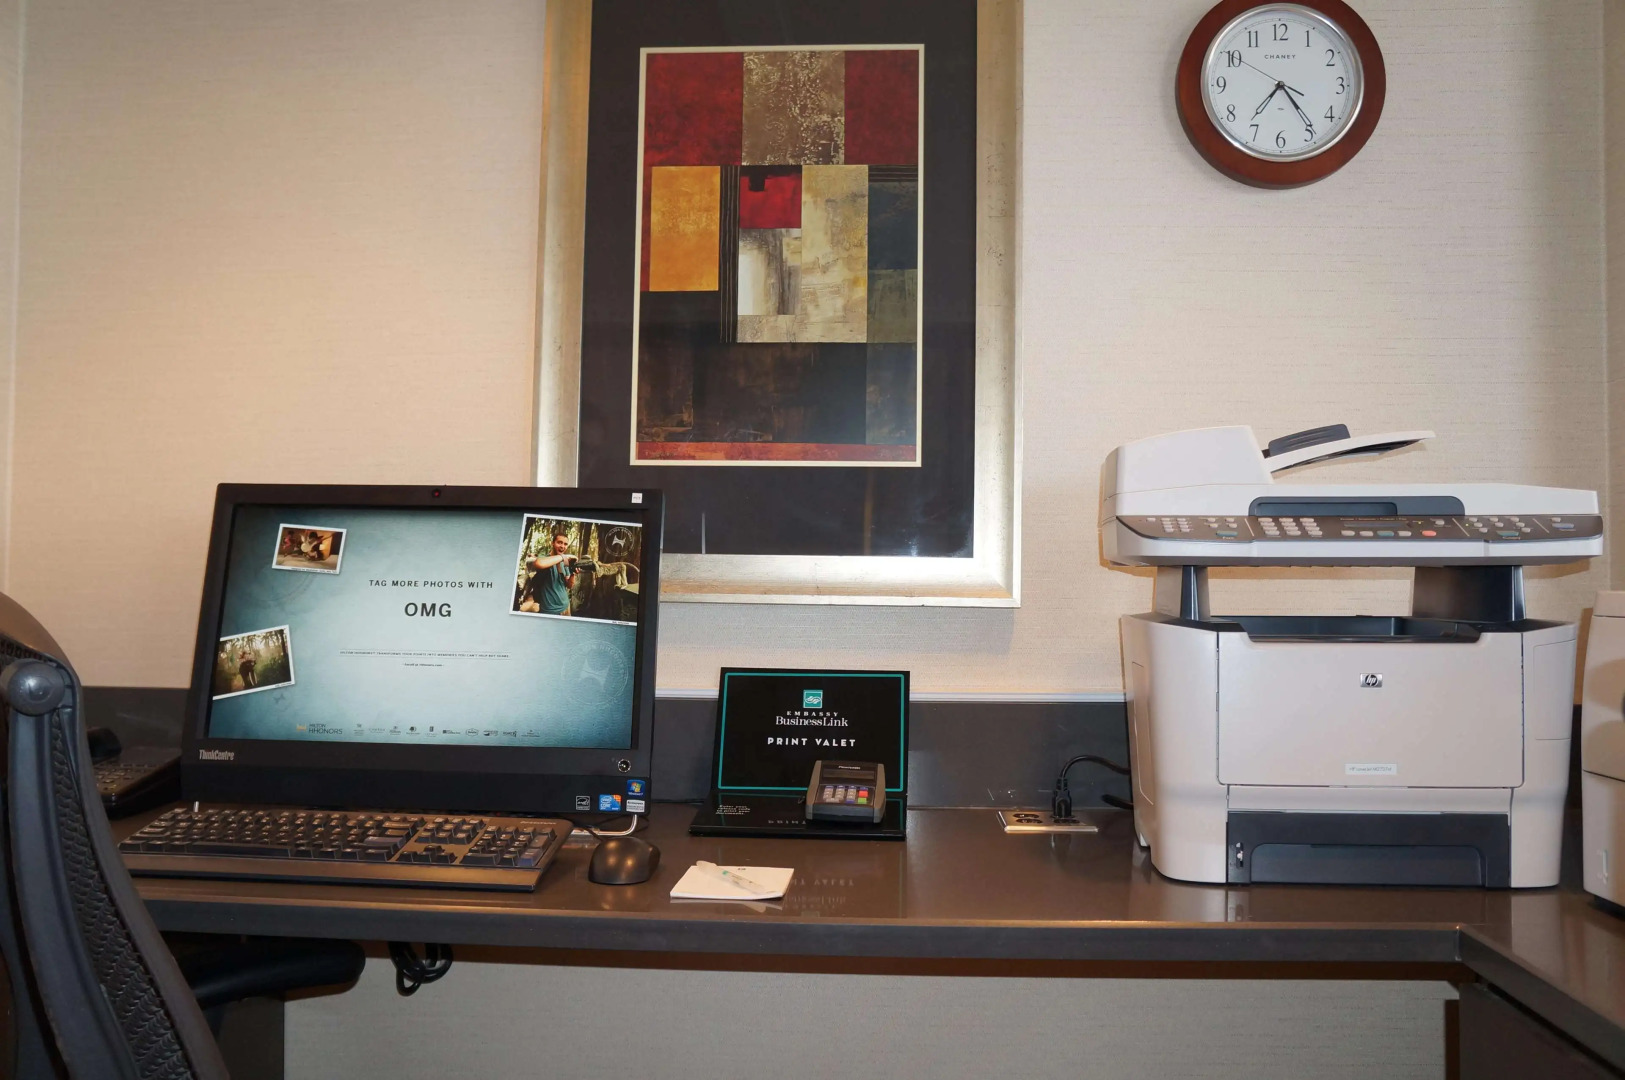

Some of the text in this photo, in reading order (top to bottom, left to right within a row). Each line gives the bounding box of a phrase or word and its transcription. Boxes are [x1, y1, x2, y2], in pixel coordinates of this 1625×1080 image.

[1247, 30, 1260, 48] 11
[1272, 23, 1289, 41] 12
[1305, 30, 1311, 48] 1
[1226, 50, 1242, 68] 10
[1325, 48, 1336, 67] 2
[1216, 76, 1227, 95] 9
[1335, 76, 1345, 95] 3
[1226, 104, 1236, 123] 8
[1323, 105, 1335, 123] 4
[1249, 124, 1260, 142] 7
[1275, 130, 1286, 149] 6
[1304, 125, 1314, 142] 5
[369, 579, 387, 587] TAG
[423, 580, 464, 588] PHOTOS
[468, 581, 493, 589] WITH
[404, 602, 452, 618] OMG
[775, 715, 849, 728] BusinessLink
[767, 737, 856, 747] PRINT VALET
